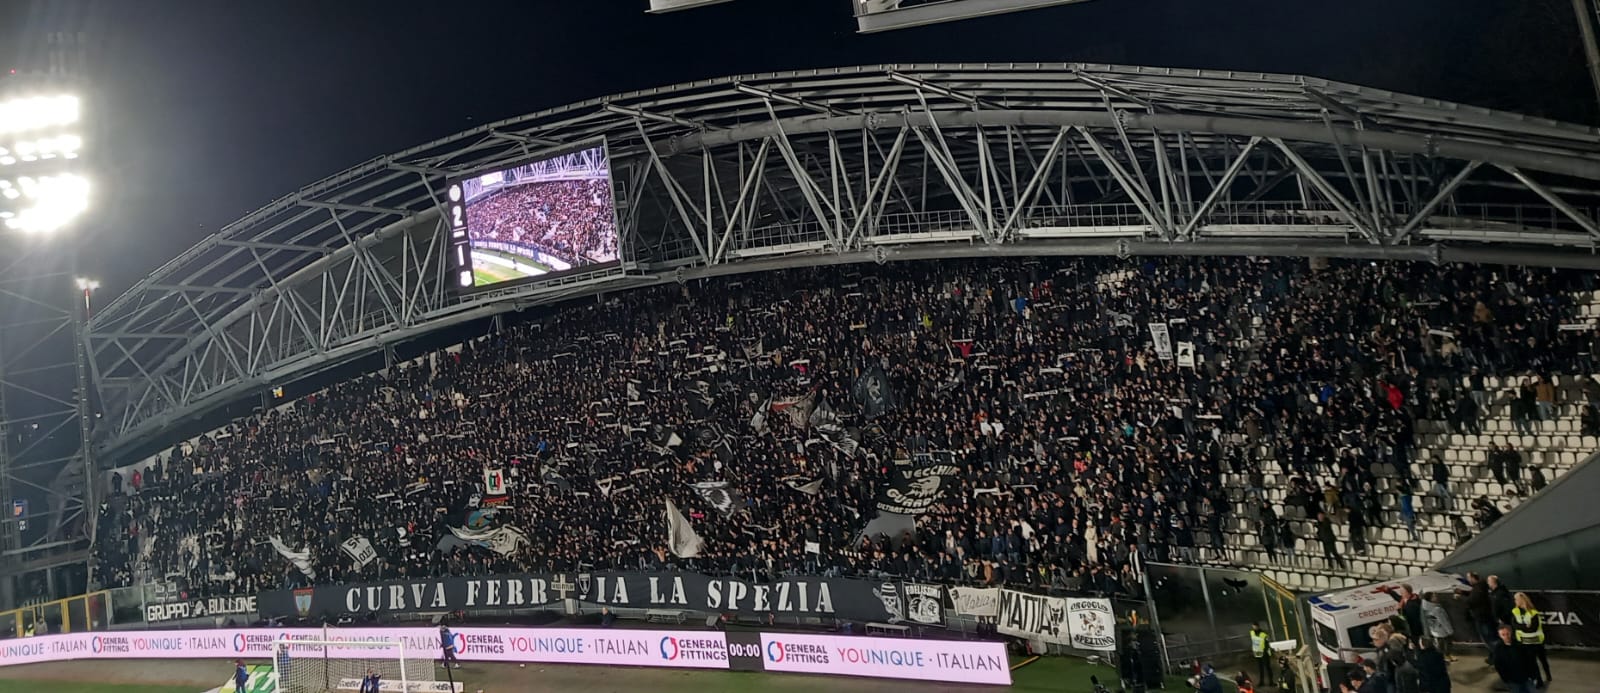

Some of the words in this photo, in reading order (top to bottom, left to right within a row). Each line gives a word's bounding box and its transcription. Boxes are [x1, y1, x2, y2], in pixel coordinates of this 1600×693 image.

[452, 205, 463, 227] 2
[902, 465, 957, 479] VECCHIA
[346, 582, 447, 612] CURVA
[466, 576, 629, 606] FERRIA
[649, 576, 688, 604] LA
[706, 579, 835, 613] SPEZIA
[147, 602, 190, 621] GRUPPO
[208, 596, 257, 614] BULLONE
[1000, 592, 1053, 635] MATTIA
[1358, 609, 1382, 618] CROCE
[1538, 611, 1583, 626] EZIA
[103, 637, 129, 646] GENERAL
[133, 638, 182, 651] YOUNIQUE
[189, 637, 226, 649] ITALIAN
[466, 634, 504, 644] GENERAL
[508, 637, 583, 653] YOUNIQUE
[594, 639, 649, 655] ITALIAN
[679, 639, 725, 649] GENERAL
[0, 643, 44, 658] UNIQUE
[52, 640, 87, 652] ITALIAN
[247, 644, 273, 652] FITTING
[467, 644, 505, 654] FITTINGS
[680, 650, 727, 660] FITTINGS
[729, 643, 760, 657] 00:00
[784, 643, 828, 654] GENERAL
[786, 654, 829, 664] FITTINGS
[837, 647, 924, 667] YOUNIQUE
[937, 653, 1002, 671] ITALIAN
